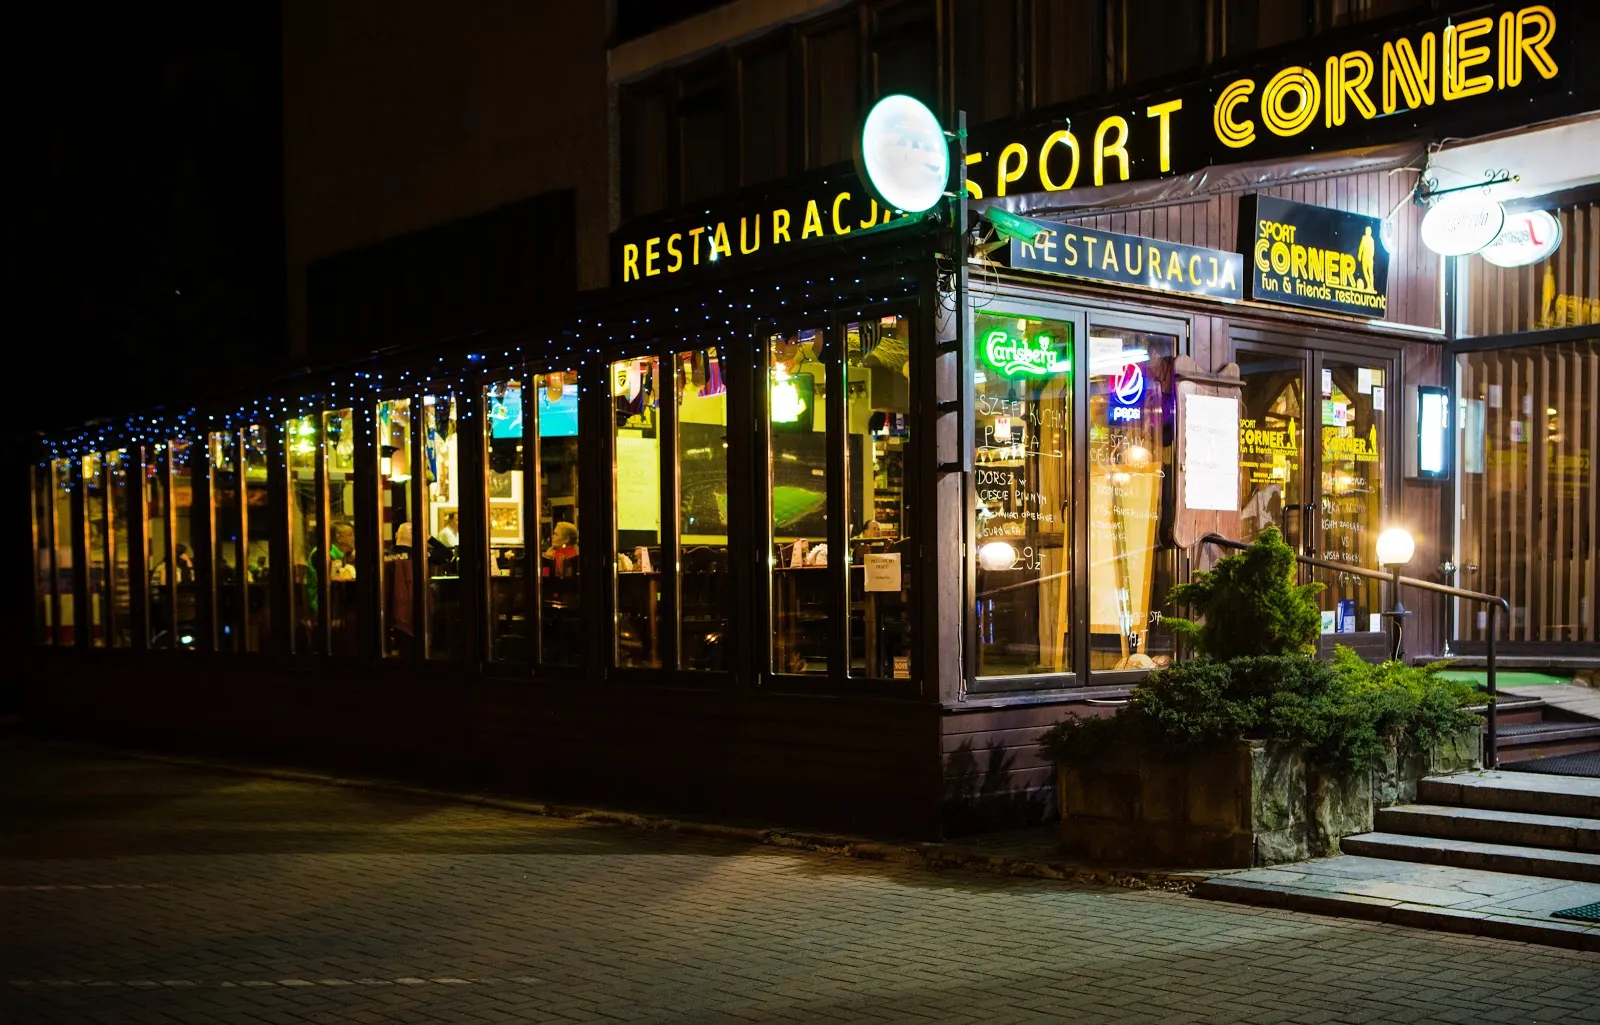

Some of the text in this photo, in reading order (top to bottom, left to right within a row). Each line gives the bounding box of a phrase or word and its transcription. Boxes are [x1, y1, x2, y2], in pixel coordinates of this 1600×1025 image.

[1213, 4, 1559, 149] CORNER
[1259, 219, 1297, 243] SPORT
[1255, 238, 1356, 288] CORNER
[1261, 272, 1387, 309] fun & friends restaurant
[986, 331, 1057, 368] Carlsberg
[1113, 406, 1141, 422] pepsi
[1239, 429, 1284, 447] CORNER
[977, 469, 1014, 486] DORSZ
